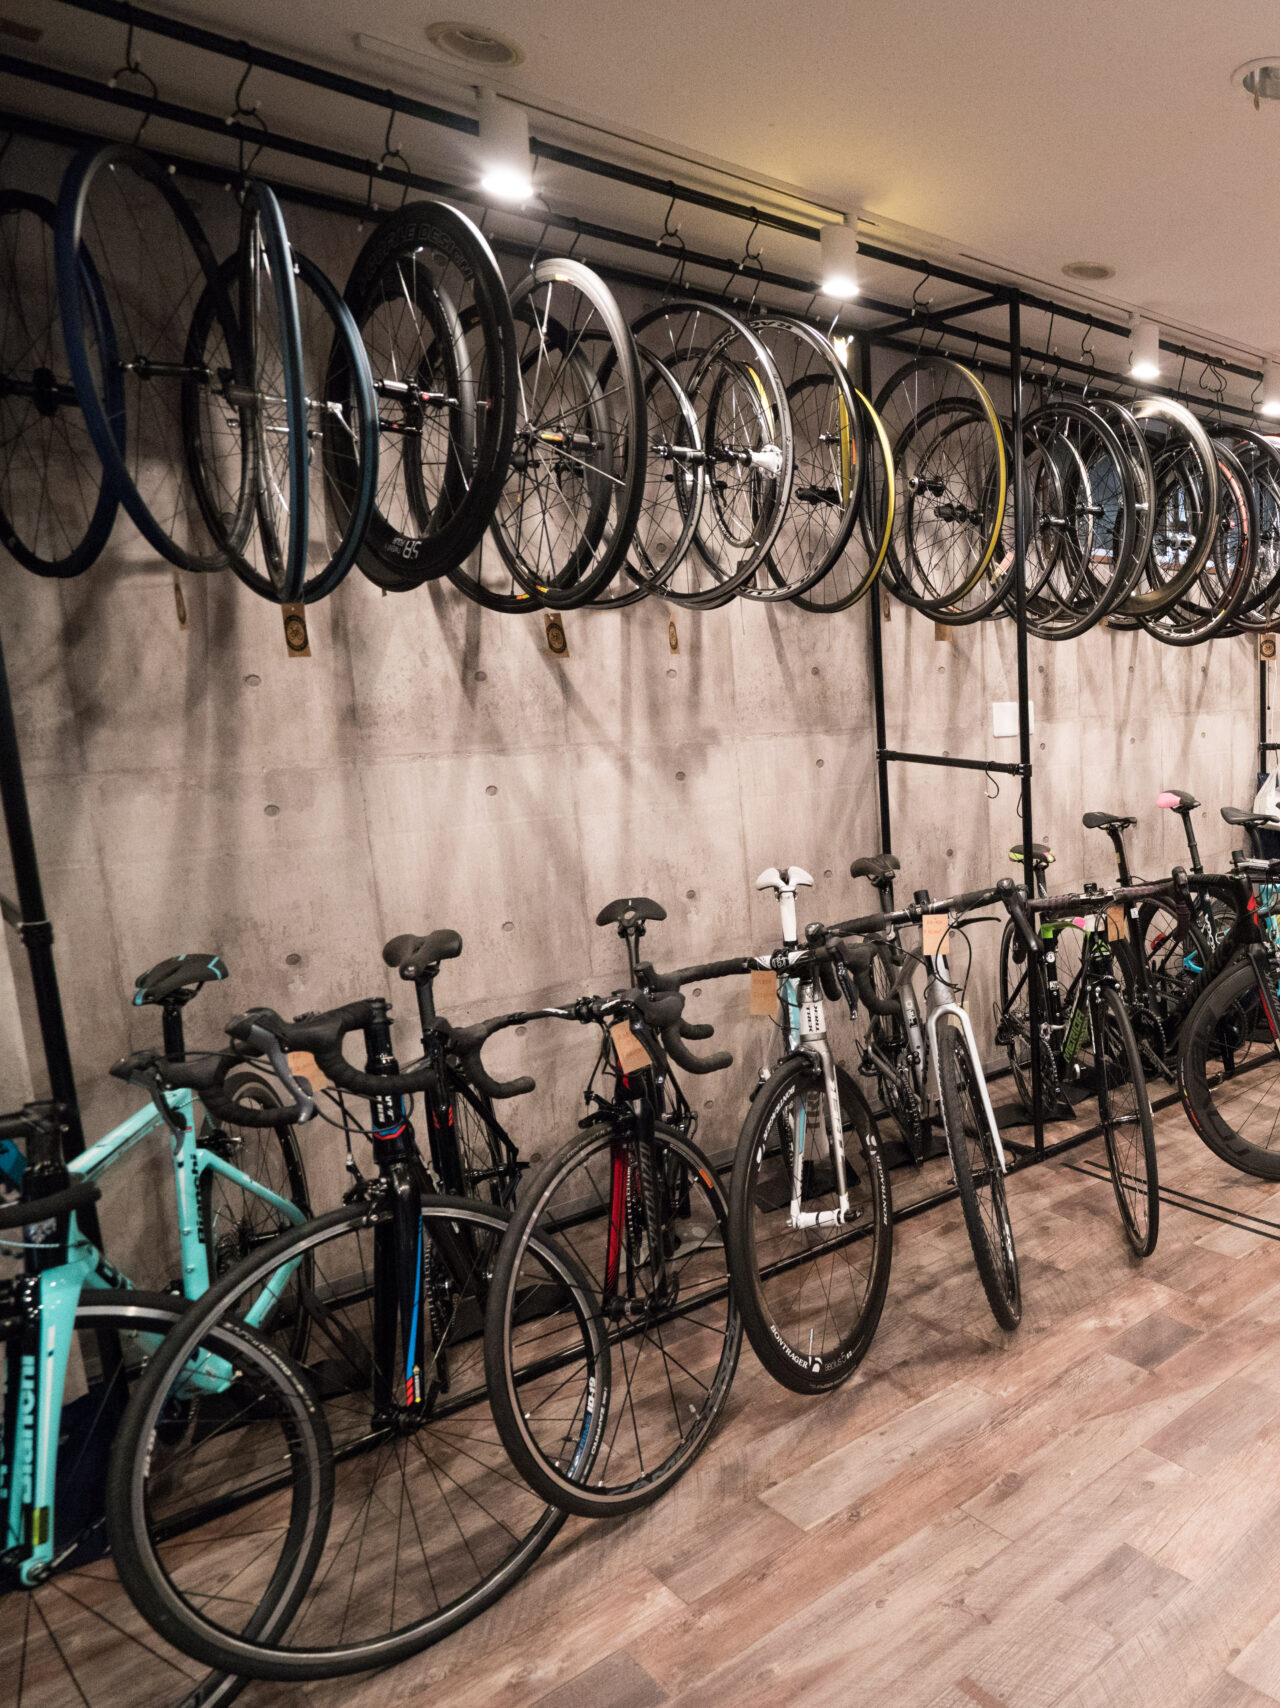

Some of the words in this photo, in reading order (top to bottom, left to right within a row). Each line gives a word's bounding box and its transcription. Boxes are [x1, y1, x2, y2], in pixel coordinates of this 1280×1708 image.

[1063, 1008, 1085, 1064] MERIDA
[763, 1085, 796, 1141] BONTRAGER
[875, 1155, 888, 1226] BONTRAGER
[770, 1324, 809, 1370] BONTRAGER
